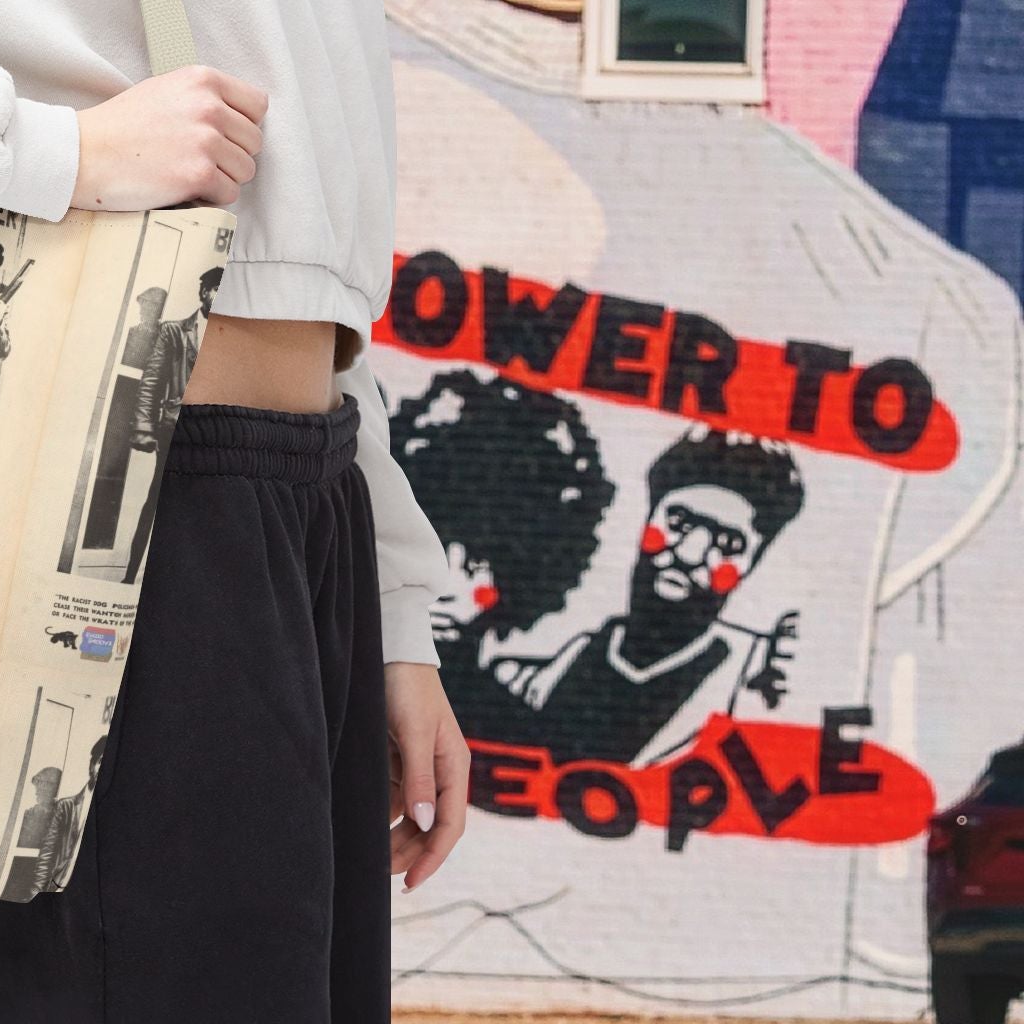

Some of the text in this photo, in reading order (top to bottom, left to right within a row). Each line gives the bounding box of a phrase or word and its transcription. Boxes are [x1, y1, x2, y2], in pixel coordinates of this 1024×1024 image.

[390, 249, 934, 454] OWER TO
[72, 597, 92, 605] RACIST
[53, 602, 70, 610] CEASE
[62, 612, 77, 620] FACE
[469, 706, 883, 852] EOPLE
